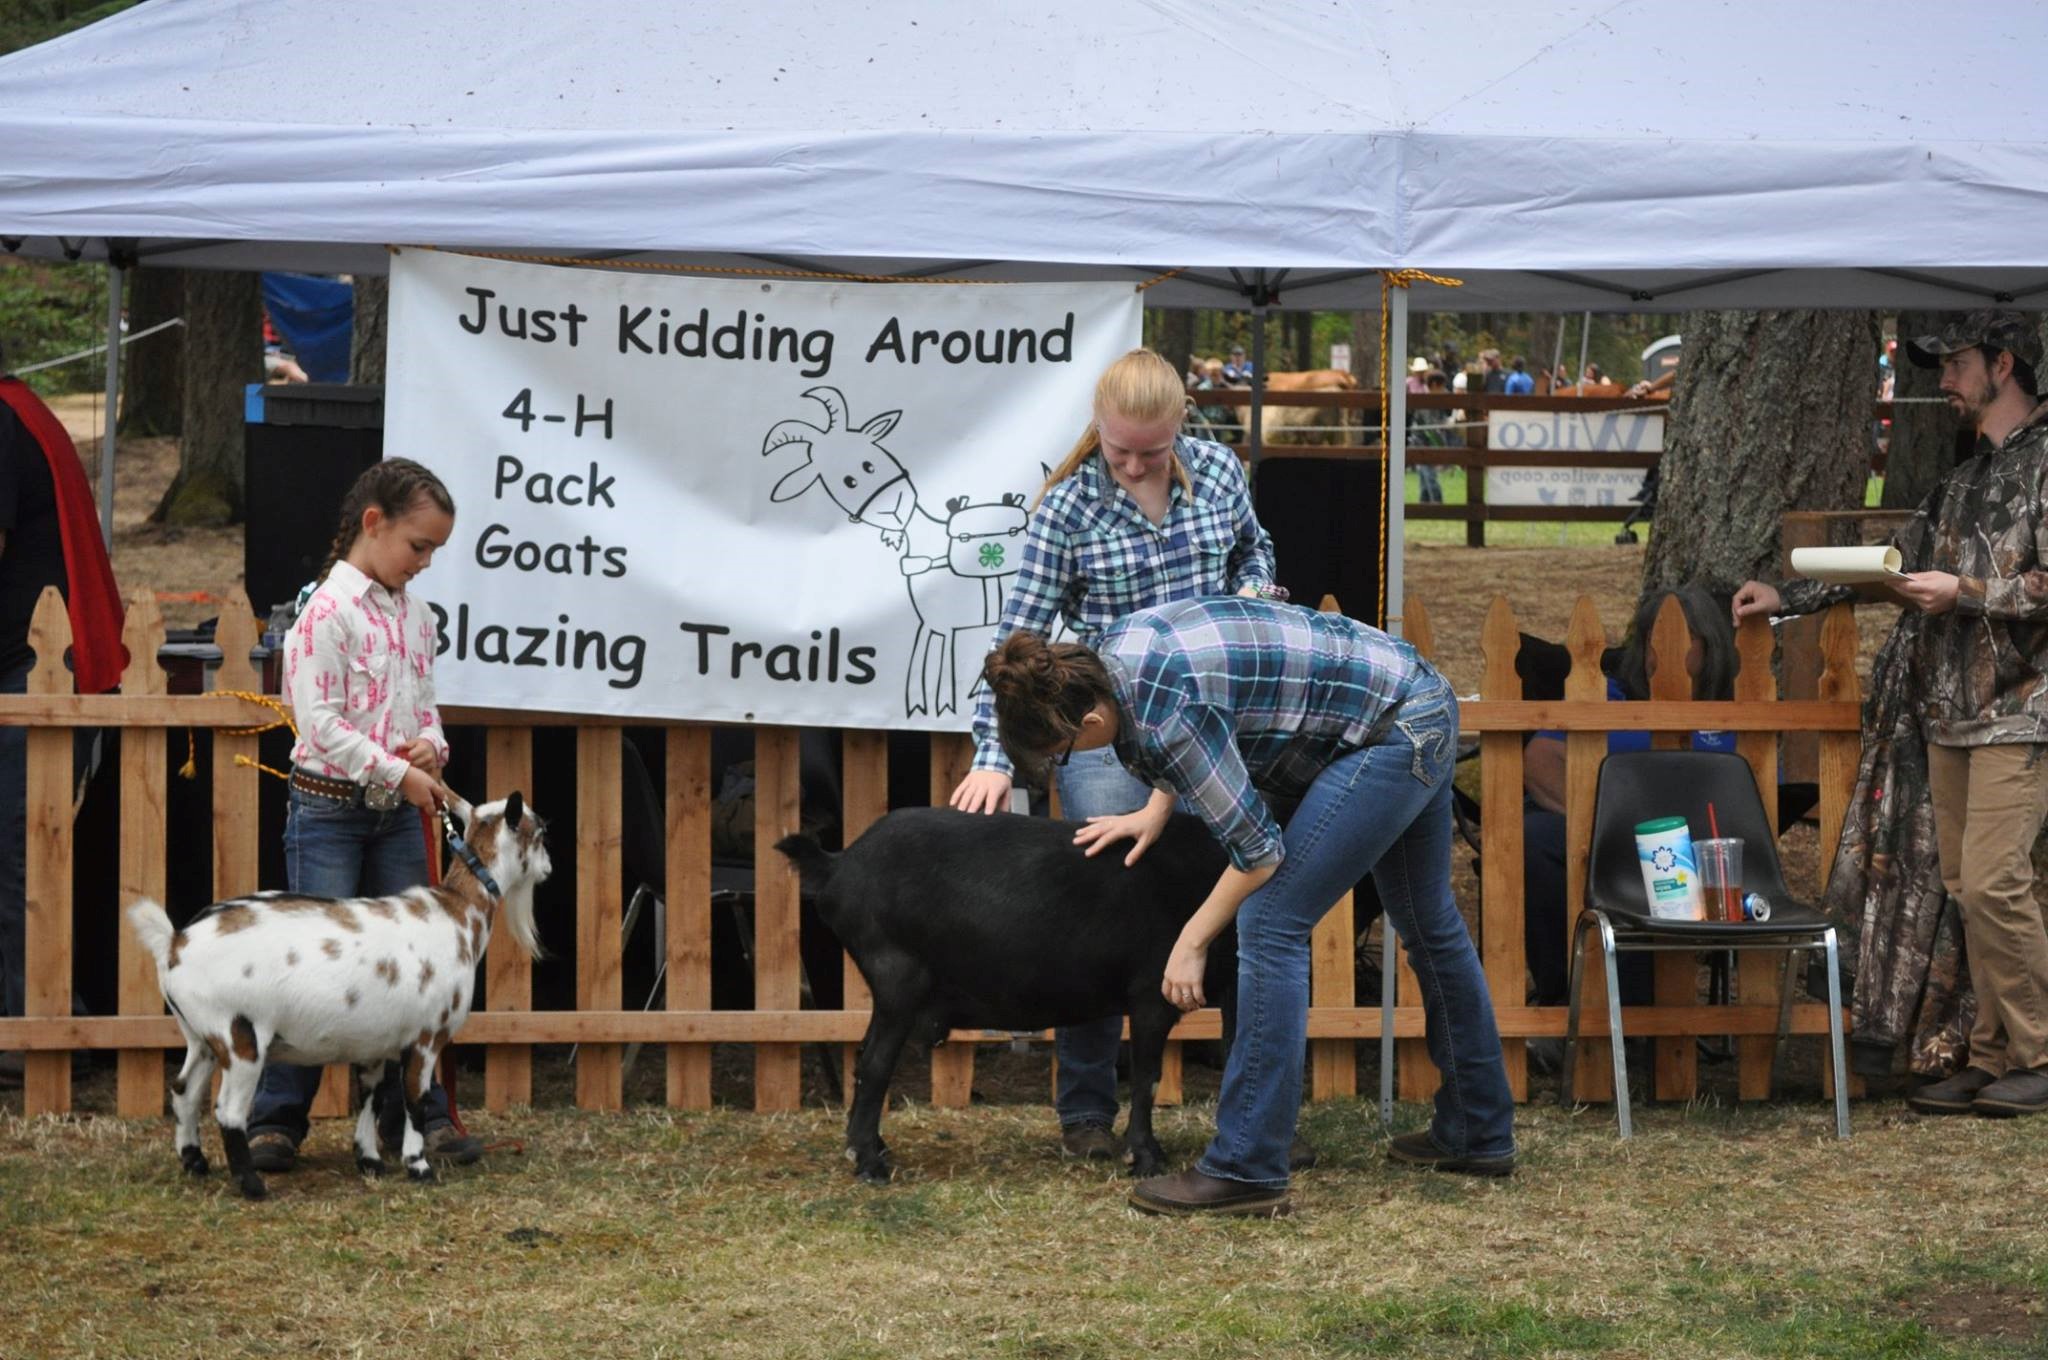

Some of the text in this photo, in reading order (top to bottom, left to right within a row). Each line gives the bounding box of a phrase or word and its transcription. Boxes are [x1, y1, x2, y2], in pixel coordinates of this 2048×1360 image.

[458, 286, 1075, 379] Just Kidding Around
[502, 388, 614, 440] 4-H
[495, 455, 615, 508] Pack
[475, 523, 627, 578] Goats
[679, 622, 877, 685] Trails
